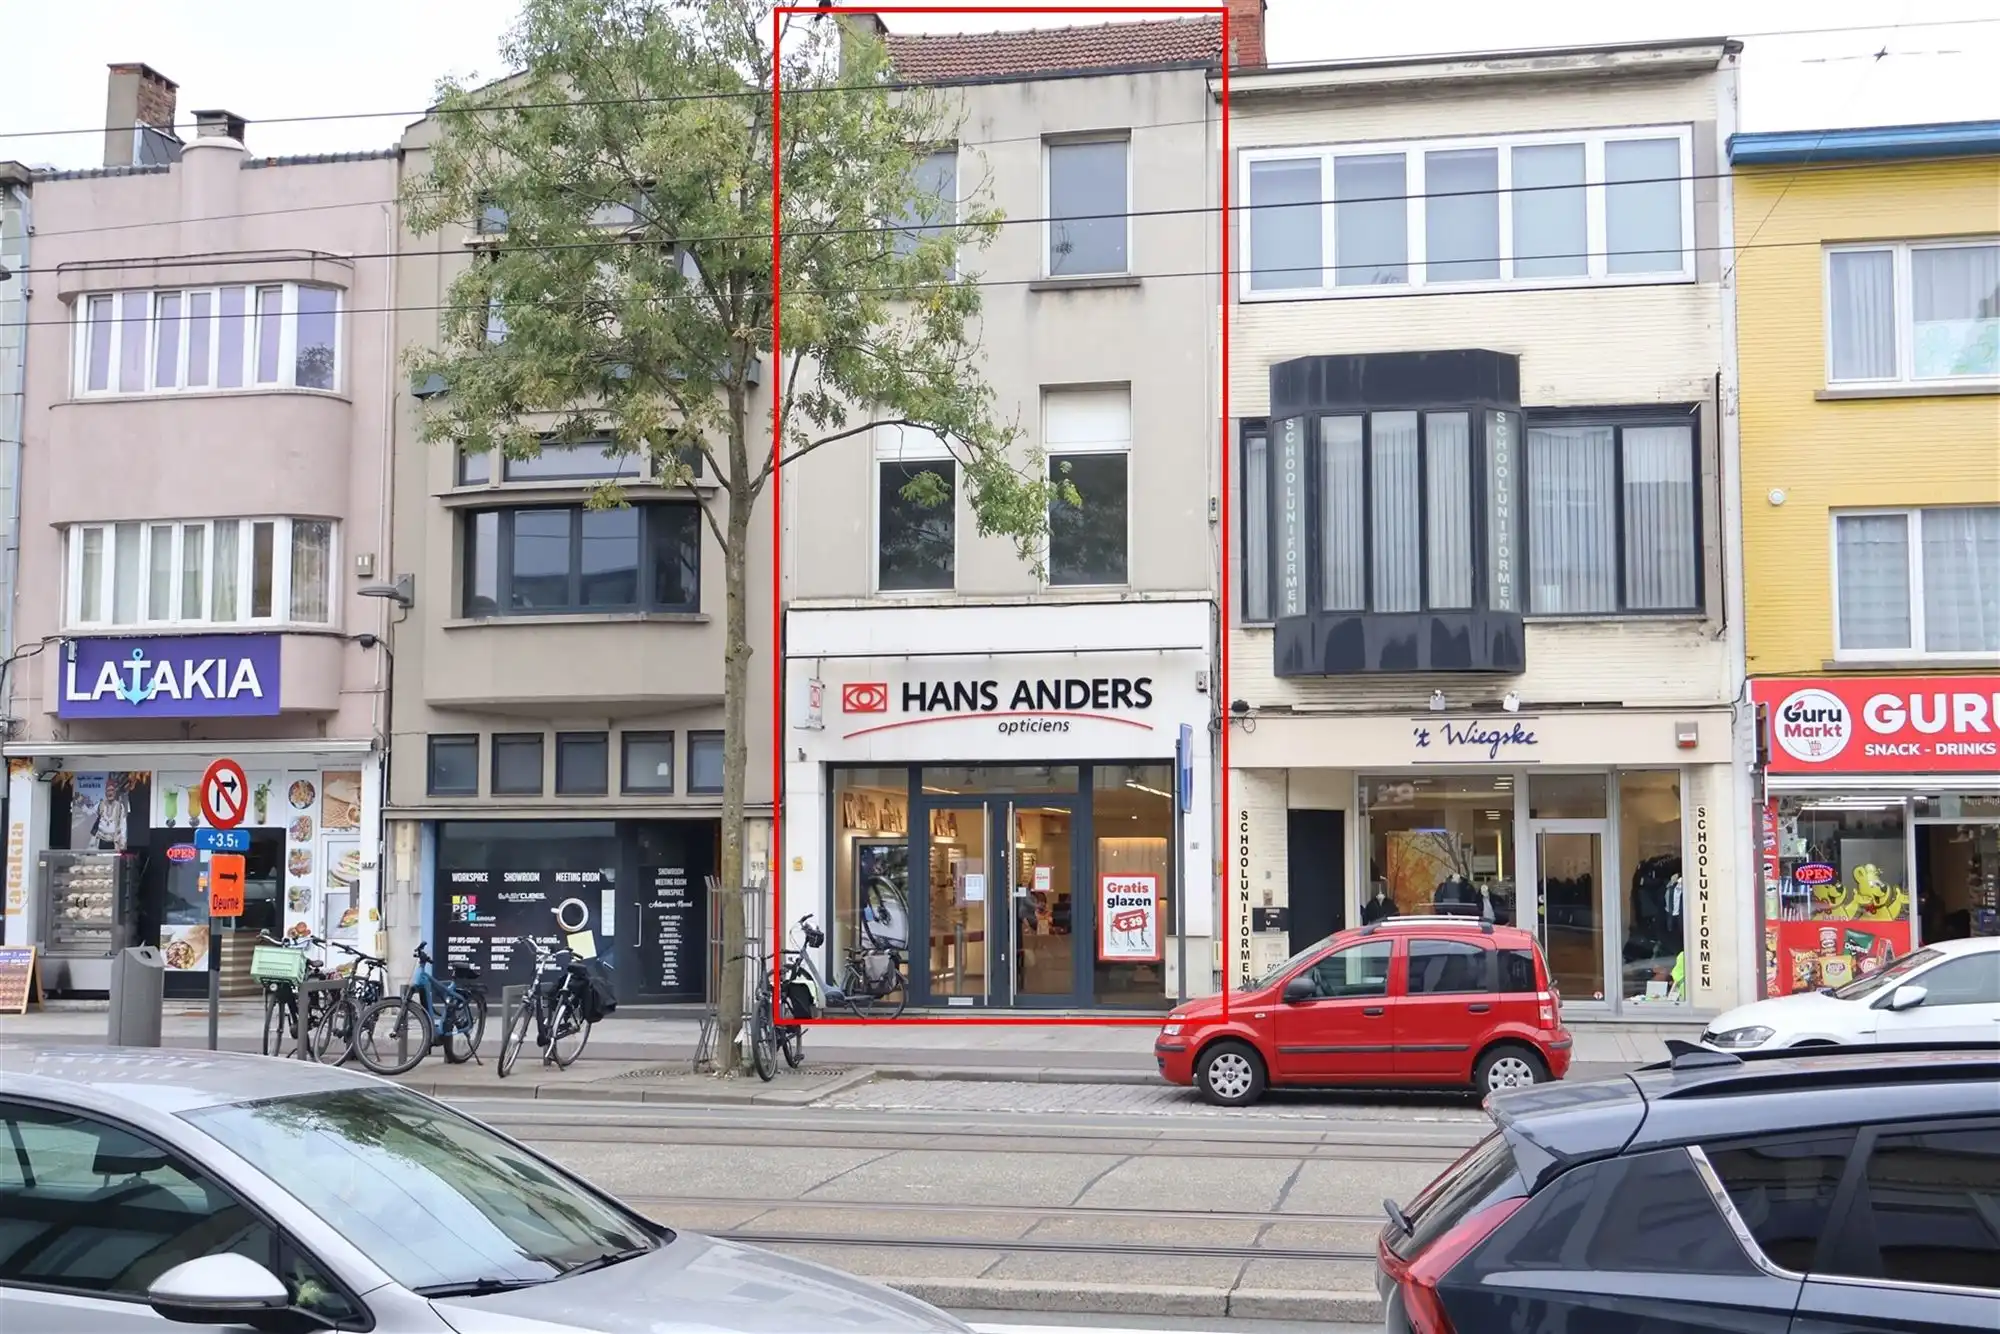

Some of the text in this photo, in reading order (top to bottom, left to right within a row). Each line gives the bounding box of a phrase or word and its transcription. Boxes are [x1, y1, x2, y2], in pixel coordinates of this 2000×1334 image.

[1285, 418, 1298, 614] SCHOOLUNIFORMEN
[1496, 412, 1510, 609] SCHOOLUNIFORMEN
[67, 648, 263, 706] LATAKIA
[902, 677, 1153, 712] HANS ANDERS
[1783, 703, 1842, 723] Guru
[1863, 693, 2000, 735] GUR
[998, 719, 1070, 736] opticiens
[1784, 723, 1842, 738] Markt
[1413, 720, 1539, 759] 't Wiegske
[1864, 743, 1921, 756] SNACK
[1935, 742, 1997, 756] DRINKS
[166, 847, 196, 860] OPEN
[451, 872, 489, 882] WORKSPACE
[503, 872, 540, 882] SHOWROOM
[555, 872, 600, 882] MEETING ROOM
[1795, 868, 1834, 880] OPEN
[1107, 882, 1149, 893] Gratis
[212, 894, 239, 910] Deurne
[1107, 895, 1151, 908] glazen
[1240, 810, 1250, 984] SCHOOLUNIFORMEN
[1697, 807, 1711, 987] SCHOOLUNIFORMEN
